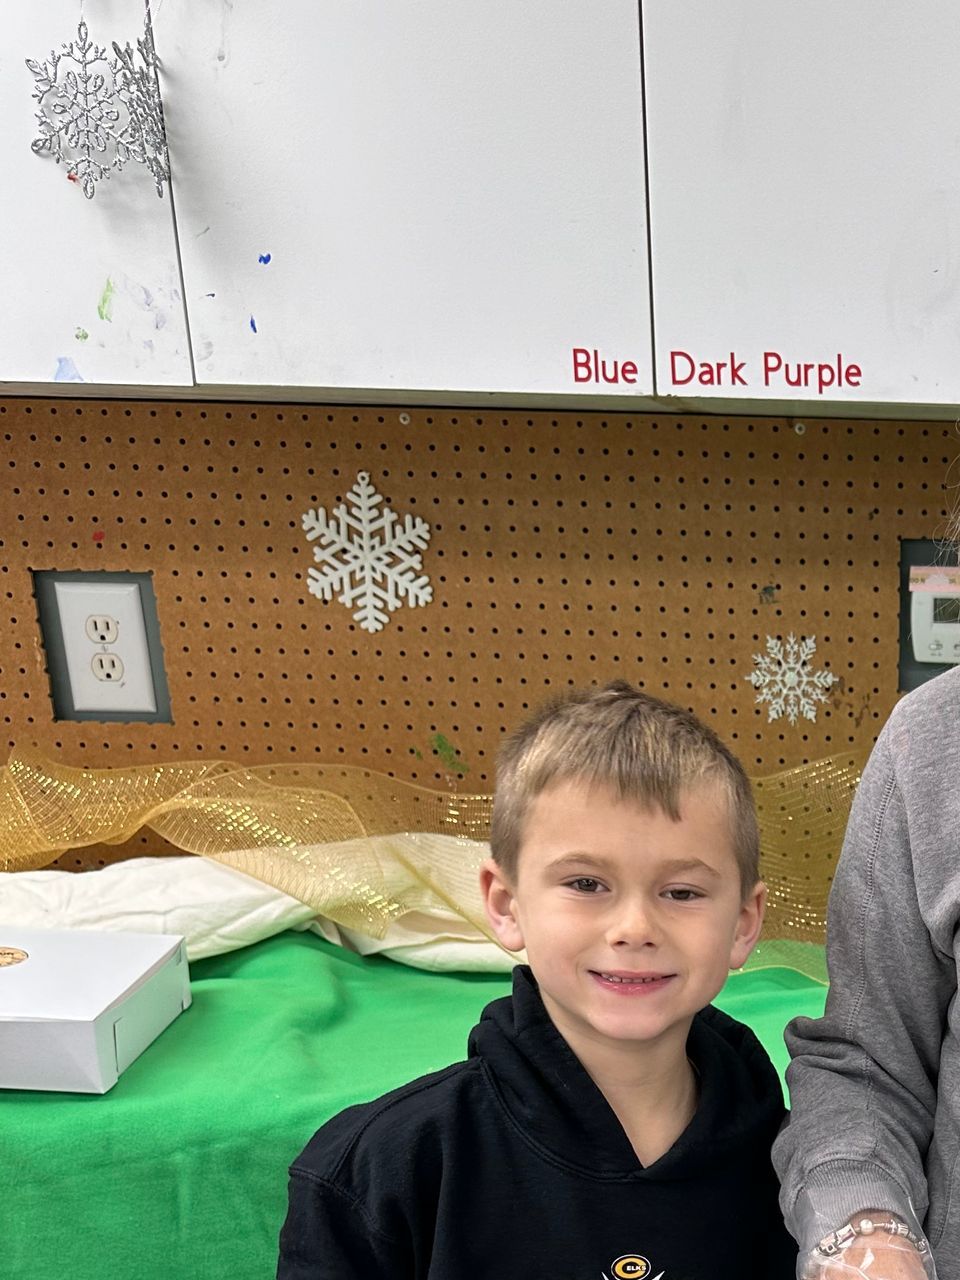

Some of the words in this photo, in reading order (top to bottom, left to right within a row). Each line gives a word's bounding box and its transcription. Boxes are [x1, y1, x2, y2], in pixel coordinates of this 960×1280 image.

[572, 348, 638, 384] Blue
[670, 351, 748, 386] Dark
[764, 352, 862, 394] Purple
